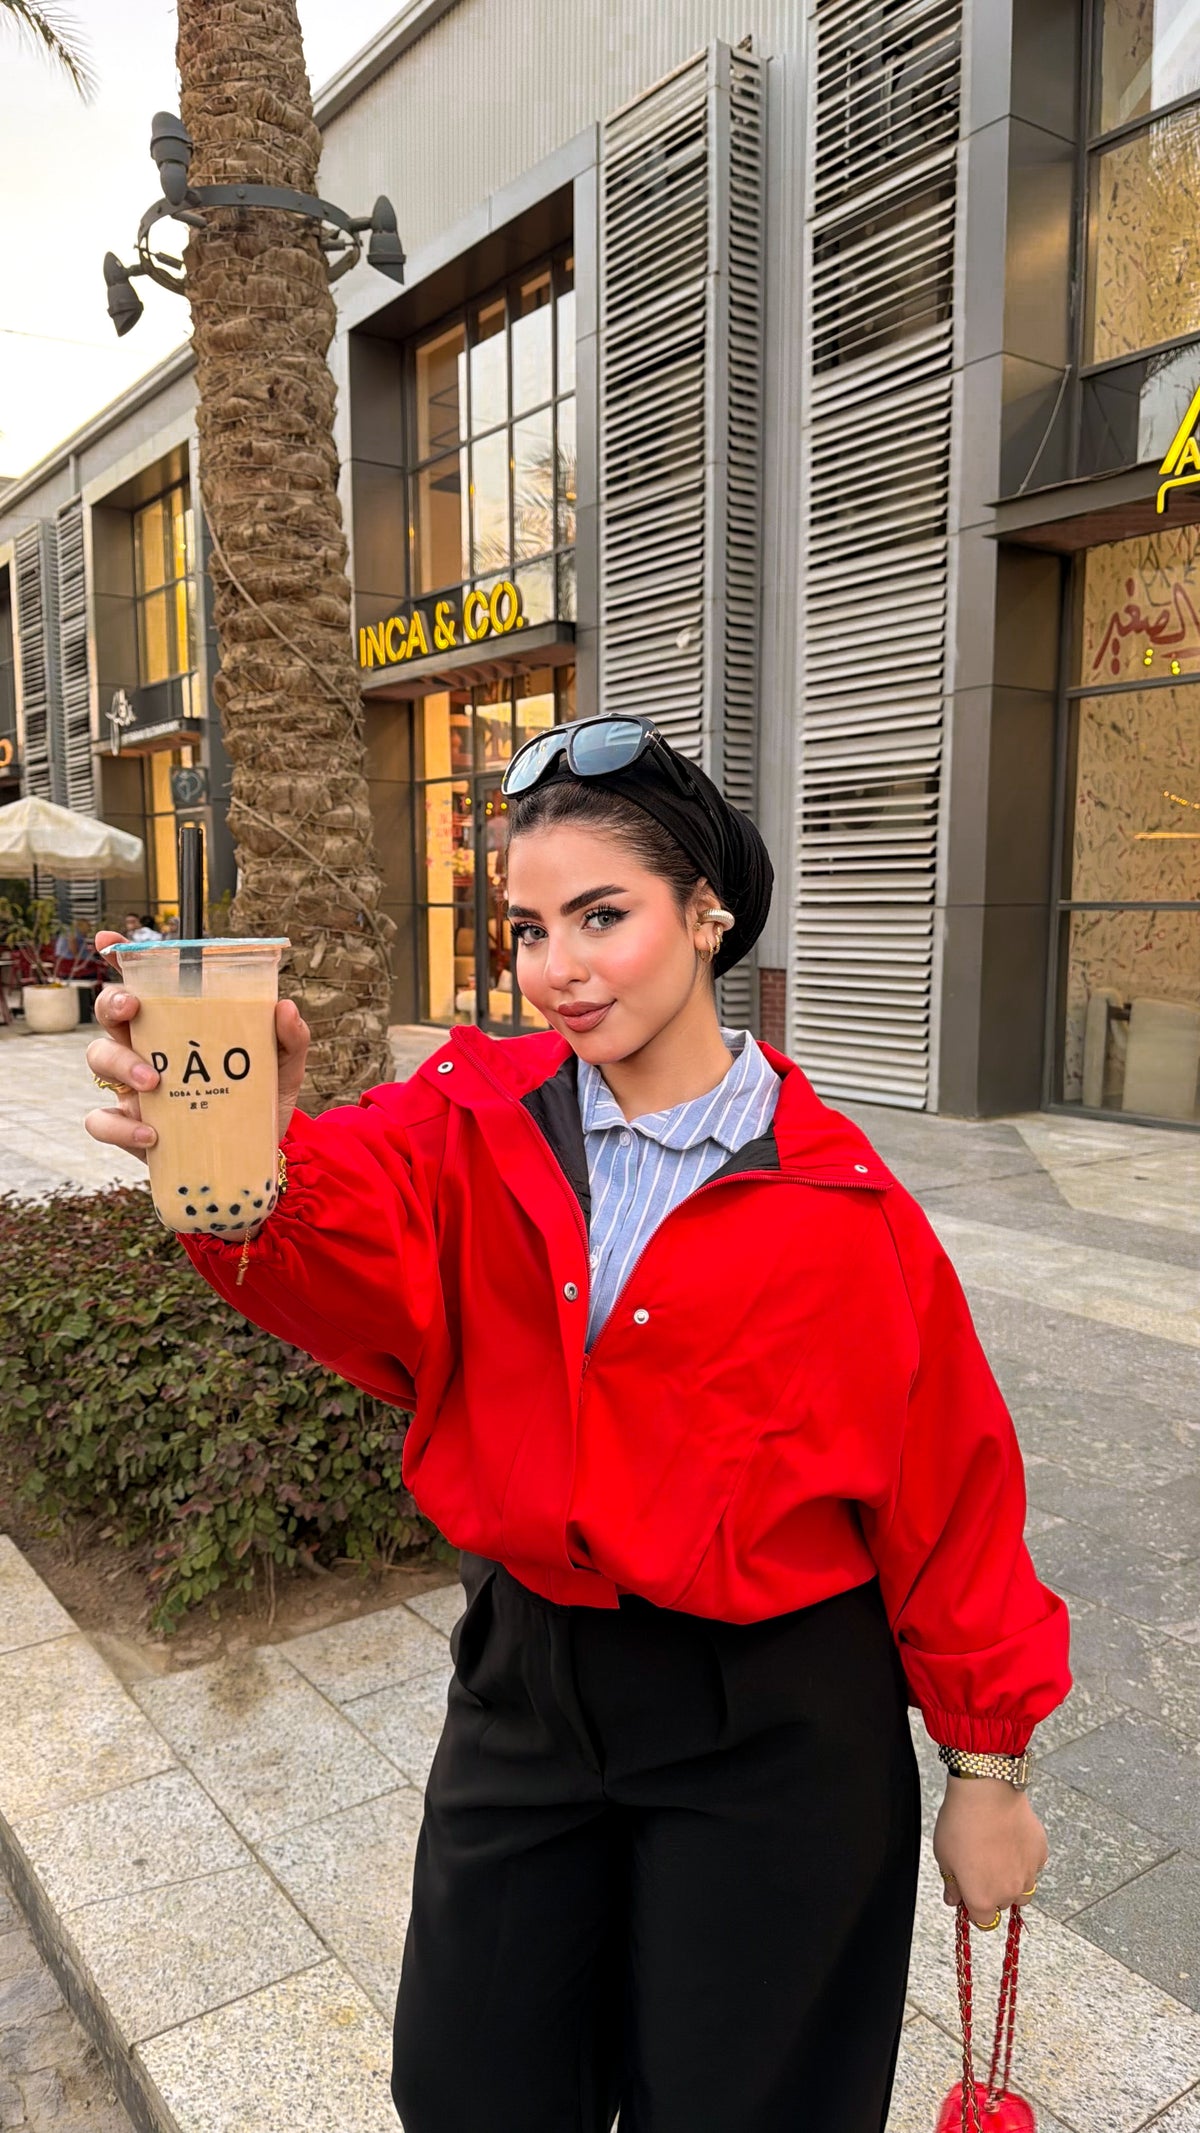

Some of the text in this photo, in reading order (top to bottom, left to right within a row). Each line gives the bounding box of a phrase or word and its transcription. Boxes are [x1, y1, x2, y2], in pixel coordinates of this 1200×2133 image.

[359, 580, 525, 668] INCA & CO.
[169, 1090, 191, 1098] BOBA
[205, 1087, 230, 1095] MORE
